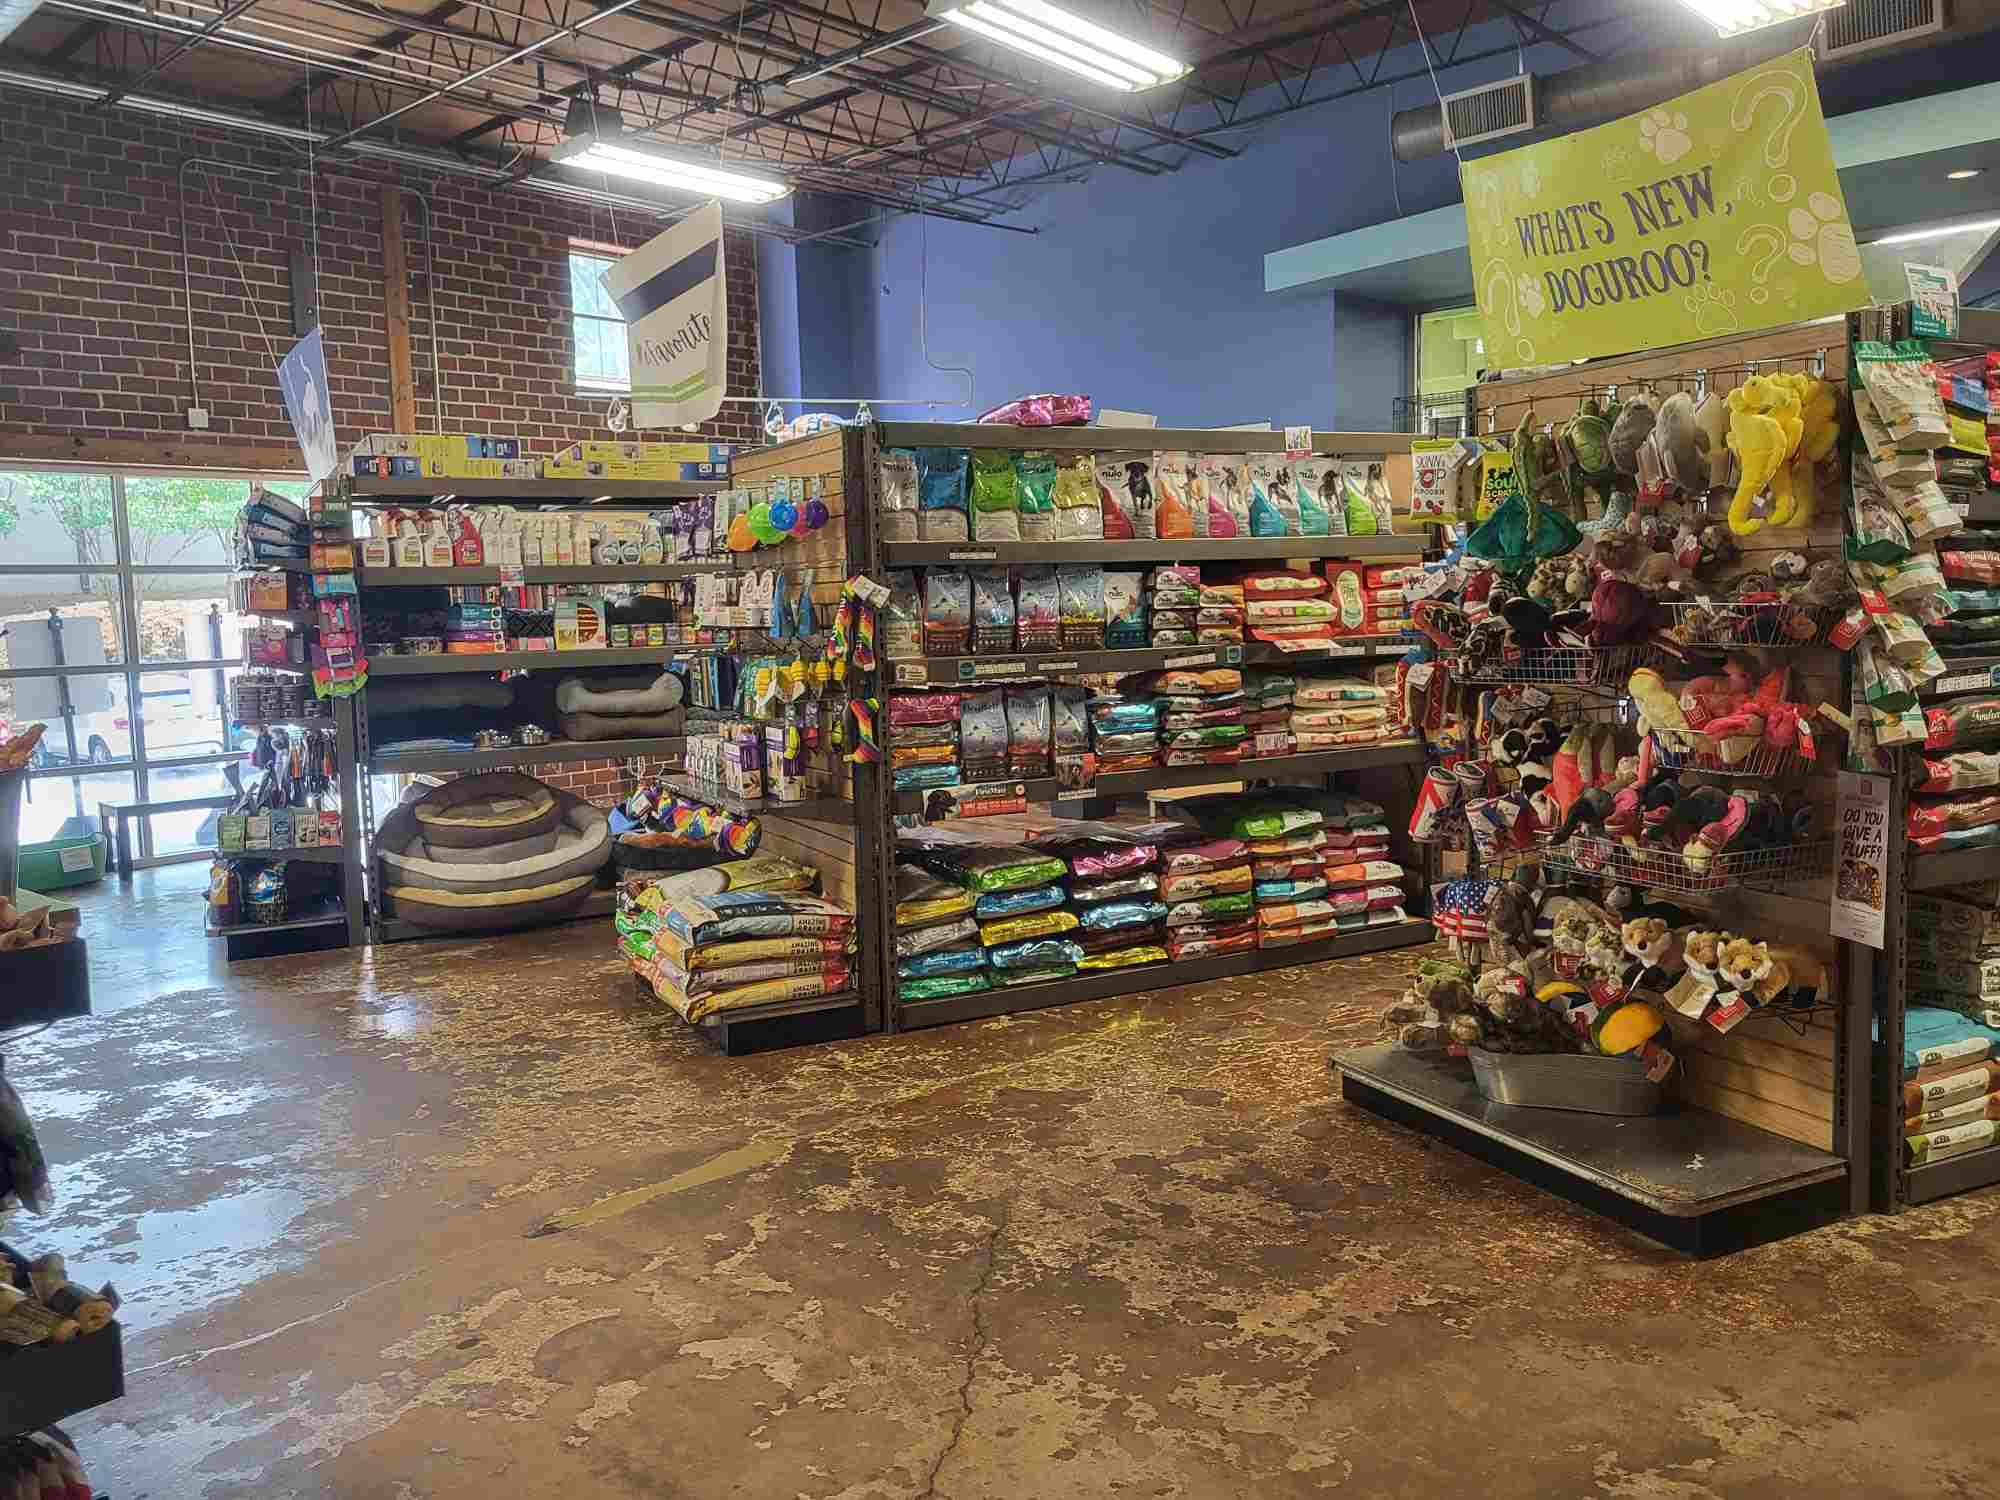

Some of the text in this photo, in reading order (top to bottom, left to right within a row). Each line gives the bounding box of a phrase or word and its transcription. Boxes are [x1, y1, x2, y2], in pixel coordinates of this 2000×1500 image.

[1515, 165, 1733, 260] WHAT'S NEW,
[1543, 239, 1713, 313] DOGUROO?
[1102, 470, 1123, 479] nulo
[1843, 808, 1884, 826] DO YOU
[1843, 824, 1882, 843] GIVE A
